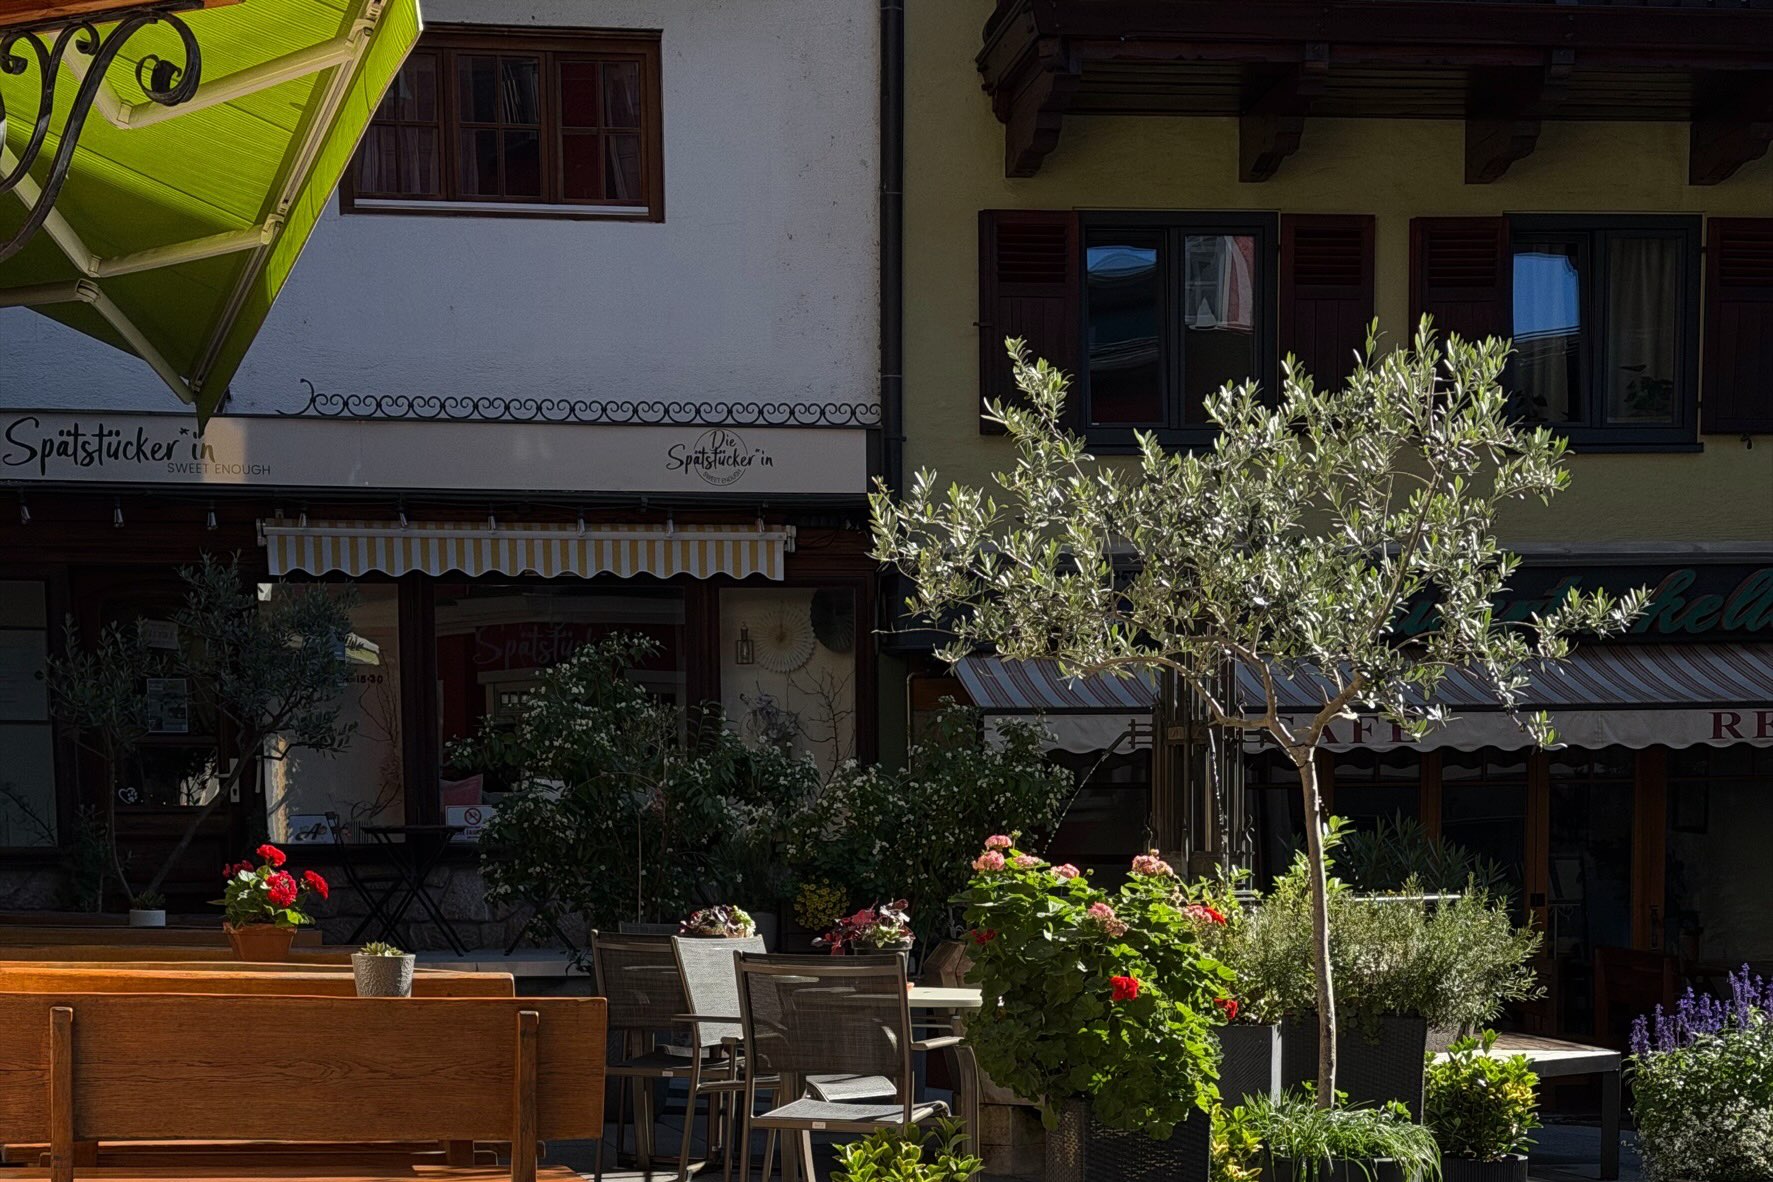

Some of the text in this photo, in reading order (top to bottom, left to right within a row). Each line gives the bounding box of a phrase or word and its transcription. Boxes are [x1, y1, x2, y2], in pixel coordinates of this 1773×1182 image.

[709, 430, 737, 451] Die
[167, 462, 271, 476] SWEET ENOUGH
[702, 471, 721, 484] SWEET
